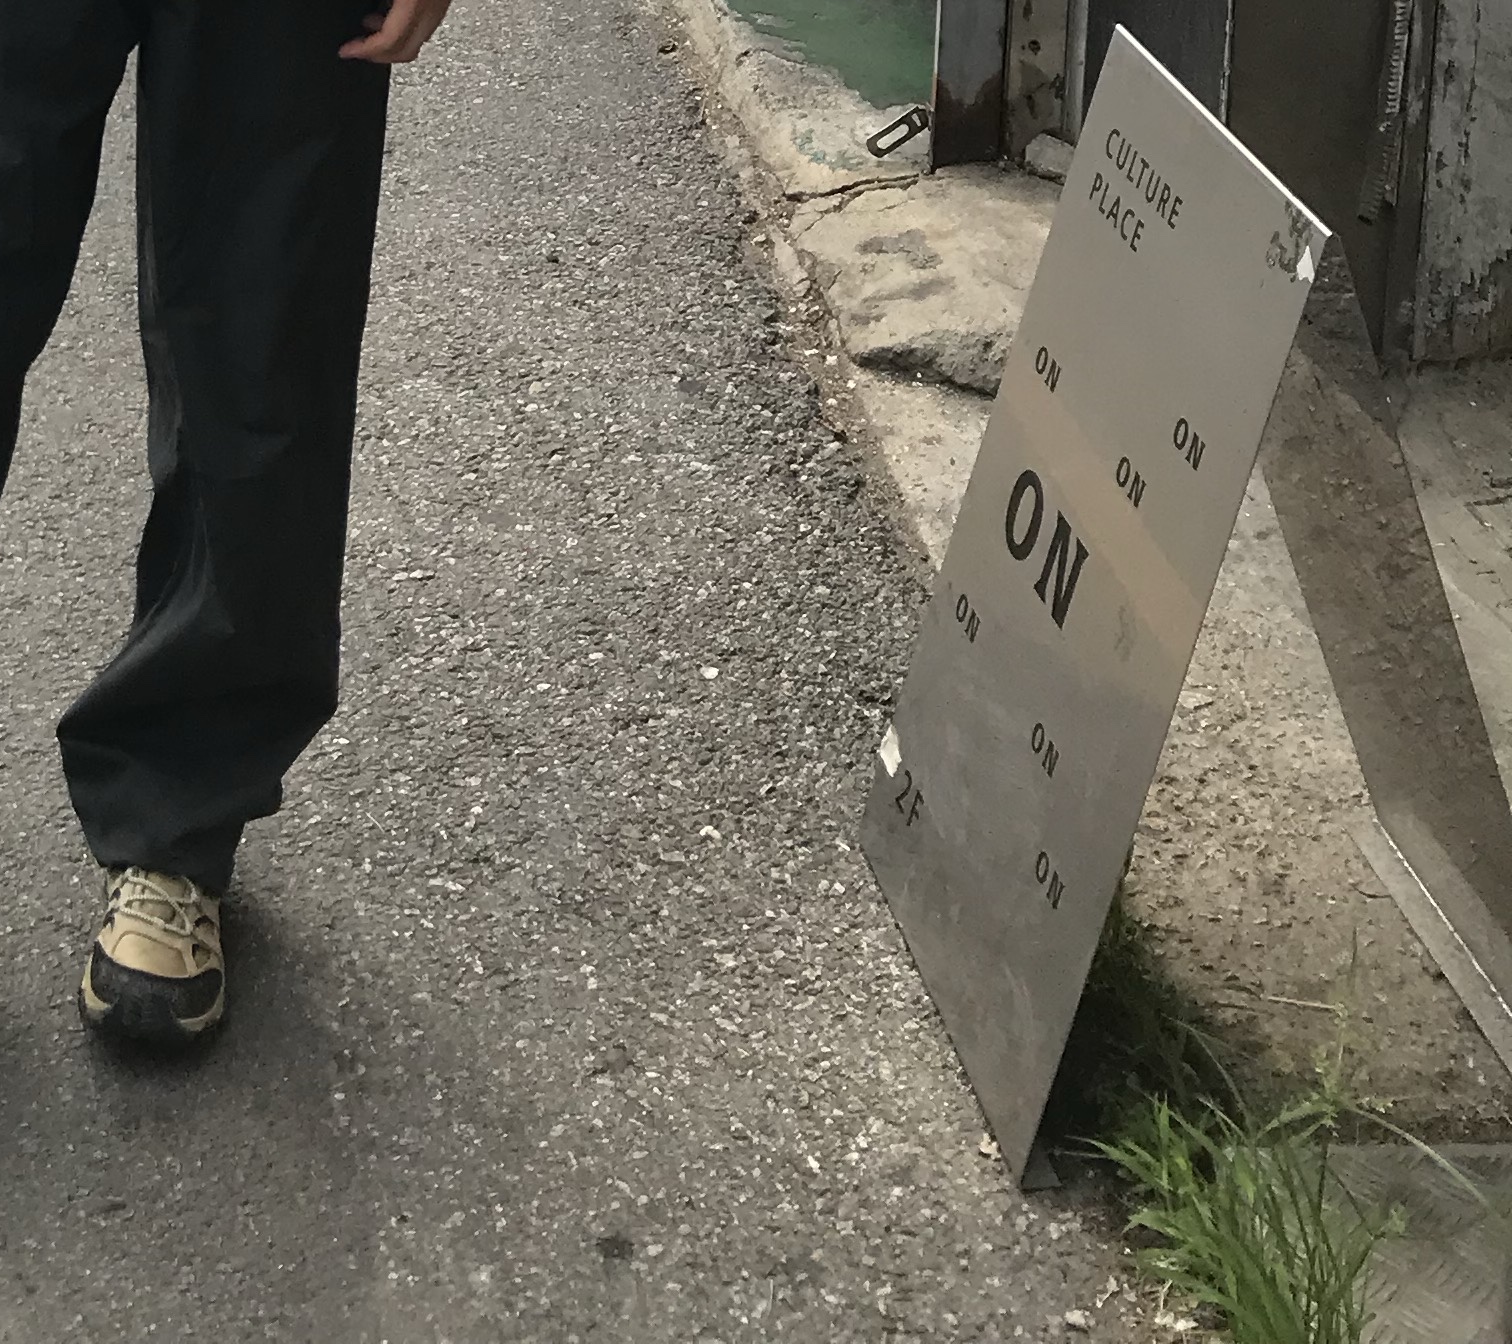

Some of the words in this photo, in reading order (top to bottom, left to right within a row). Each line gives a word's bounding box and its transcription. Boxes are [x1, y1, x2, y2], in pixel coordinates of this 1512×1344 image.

[1106, 128, 1183, 229] CULTURE
[1089, 173, 1145, 252] PLACE
[1035, 346, 1062, 393] ON
[1173, 418, 1206, 471] ON
[1116, 456, 1147, 509] ON
[1005, 469, 1090, 630] ON
[956, 593, 981, 643] ON
[1031, 721, 1059, 778] ON
[895, 770, 924, 827] 2F
[1035, 850, 1065, 909] ON
